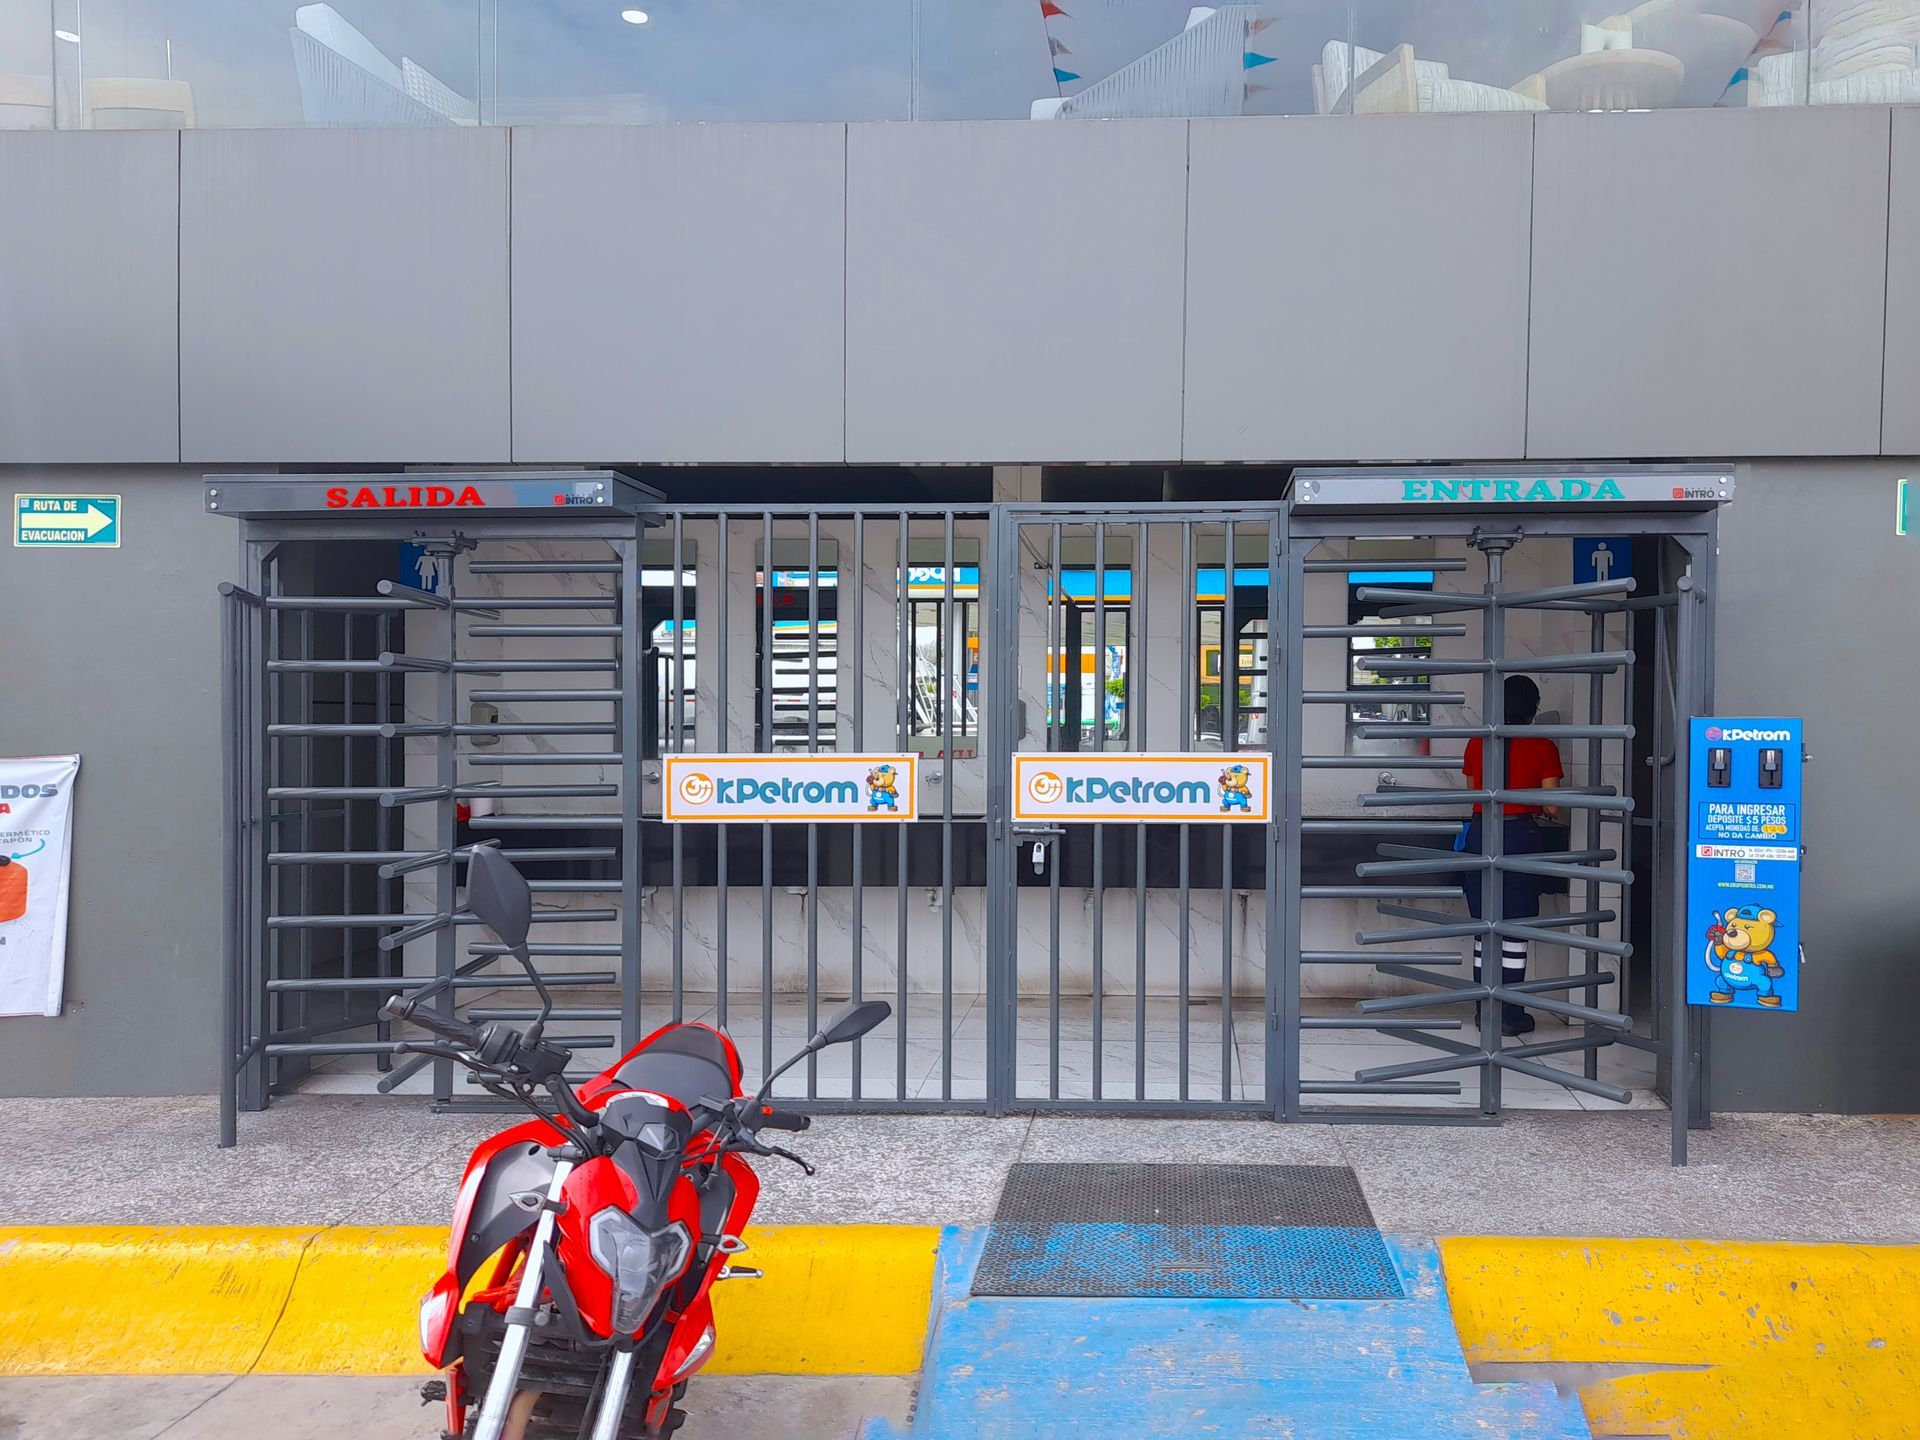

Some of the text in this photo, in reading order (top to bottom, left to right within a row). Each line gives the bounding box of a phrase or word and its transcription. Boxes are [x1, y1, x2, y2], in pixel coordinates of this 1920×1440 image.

[1401, 478, 1626, 501] ENTRADA
[326, 486, 486, 508] SALIDA
[33, 500, 77, 511] RUTA DE
[21, 530, 85, 541] EVACUACION
[1709, 803, 1786, 816] PARA INGRESAR
[1707, 814, 1744, 824] DEPOSITE
[1761, 816, 1786, 825] PESOS
[1725, 824, 1751, 832] MONEDAS
[1744, 832, 1777, 840] CAMBIO
[1713, 848, 1746, 858] INTRO
